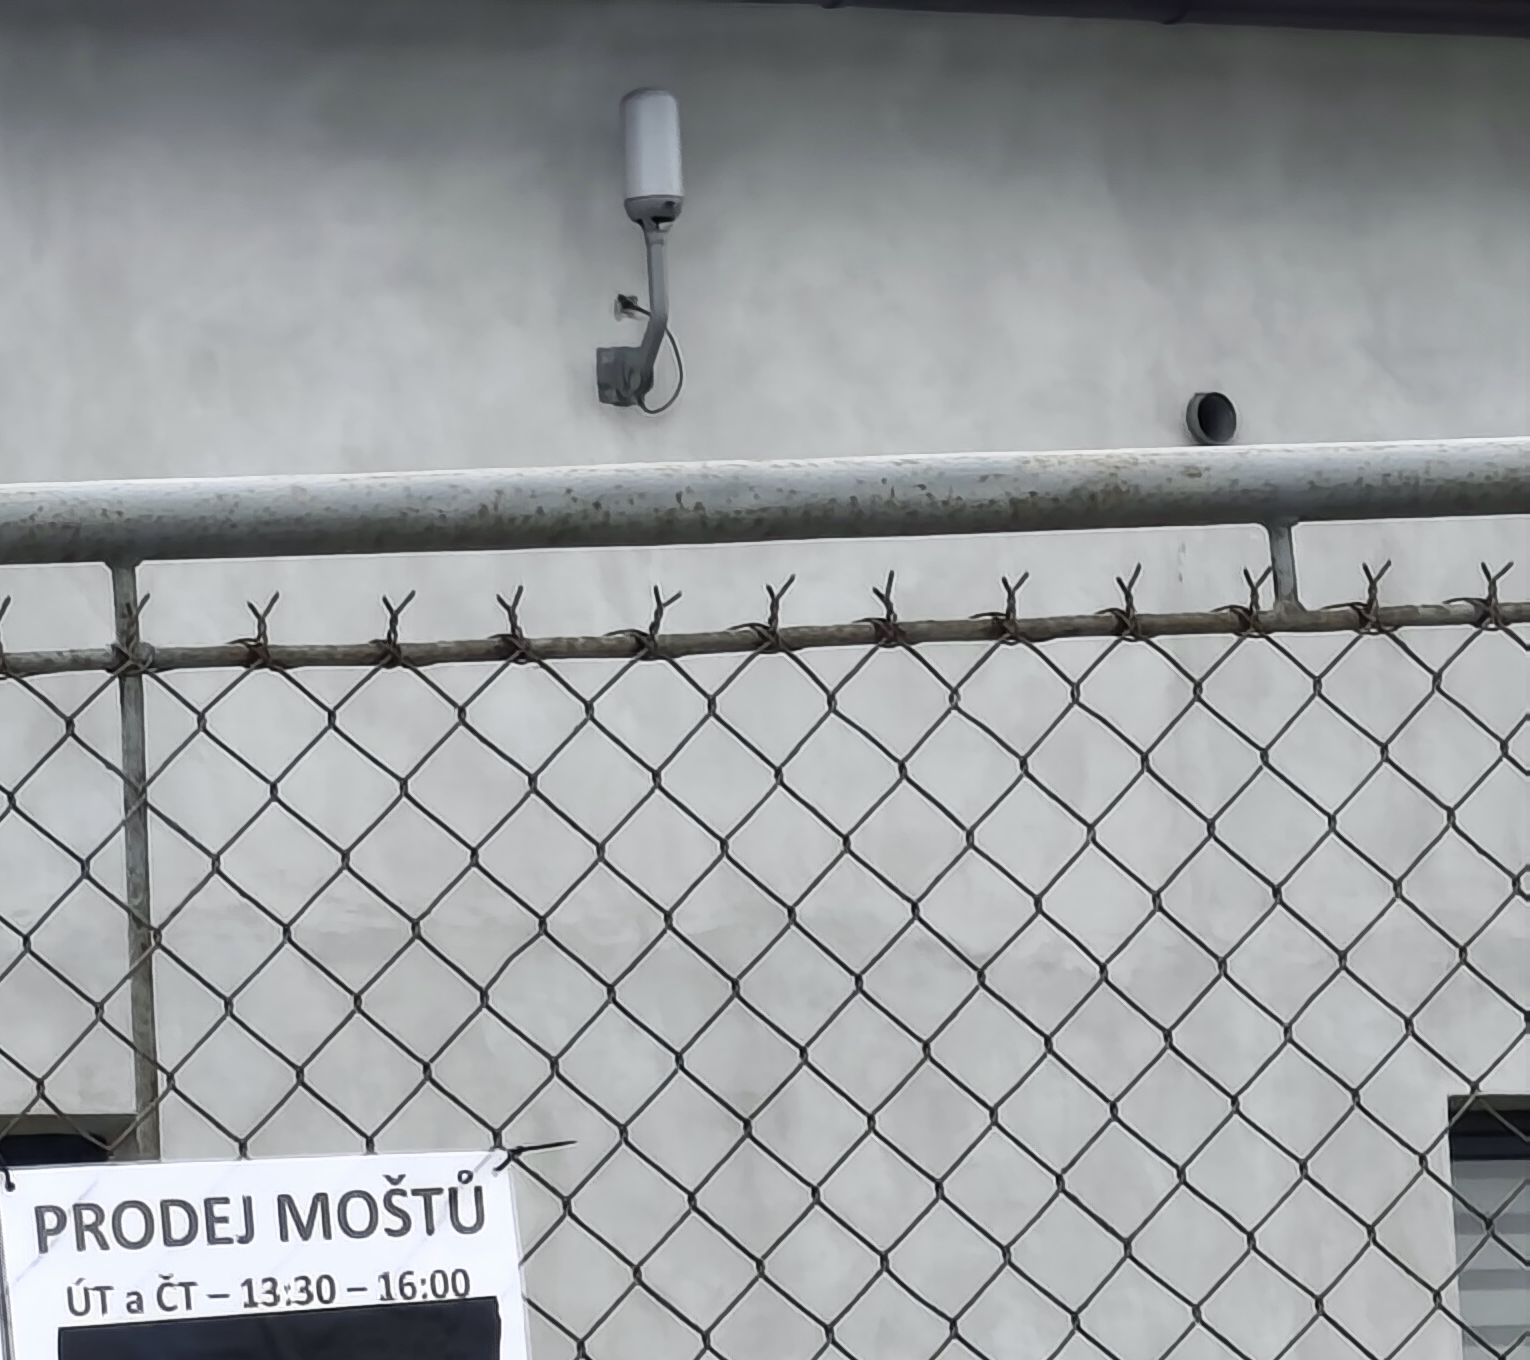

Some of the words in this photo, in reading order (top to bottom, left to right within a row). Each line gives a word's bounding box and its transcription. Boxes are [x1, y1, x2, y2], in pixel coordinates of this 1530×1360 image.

[34, 1194, 254, 1253] PRODEJ
[277, 1170, 486, 1242] MOŠTŮ
[66, 1277, 115, 1317] ÚT
[126, 1290, 144, 1315] a
[156, 1273, 198, 1312] ČT
[240, 1274, 336, 1309] 13:30
[377, 1268, 471, 1301] 16:00
